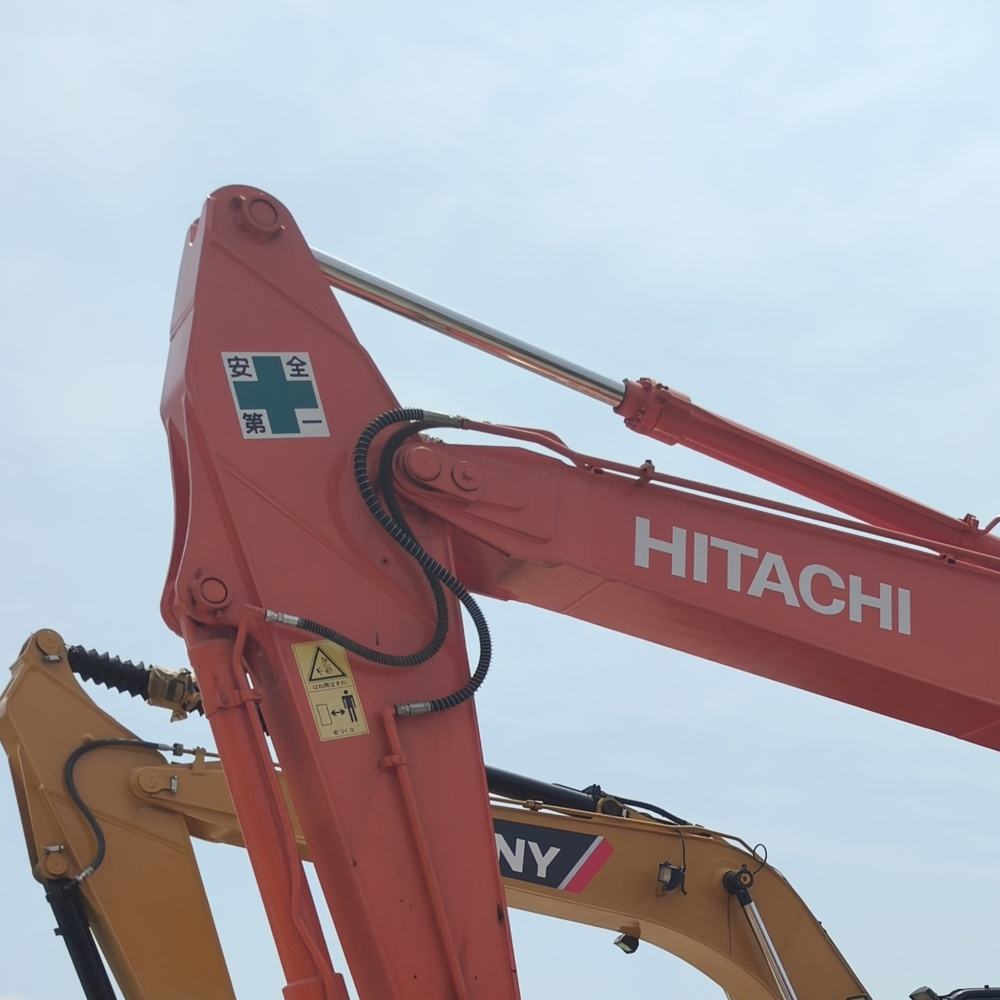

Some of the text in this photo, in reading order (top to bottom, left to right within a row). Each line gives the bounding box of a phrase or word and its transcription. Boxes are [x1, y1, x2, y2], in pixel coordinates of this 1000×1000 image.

[227, 356, 309, 378] 安全
[242, 412, 322, 434] 第一
[634, 515, 911, 635] HITACHI
